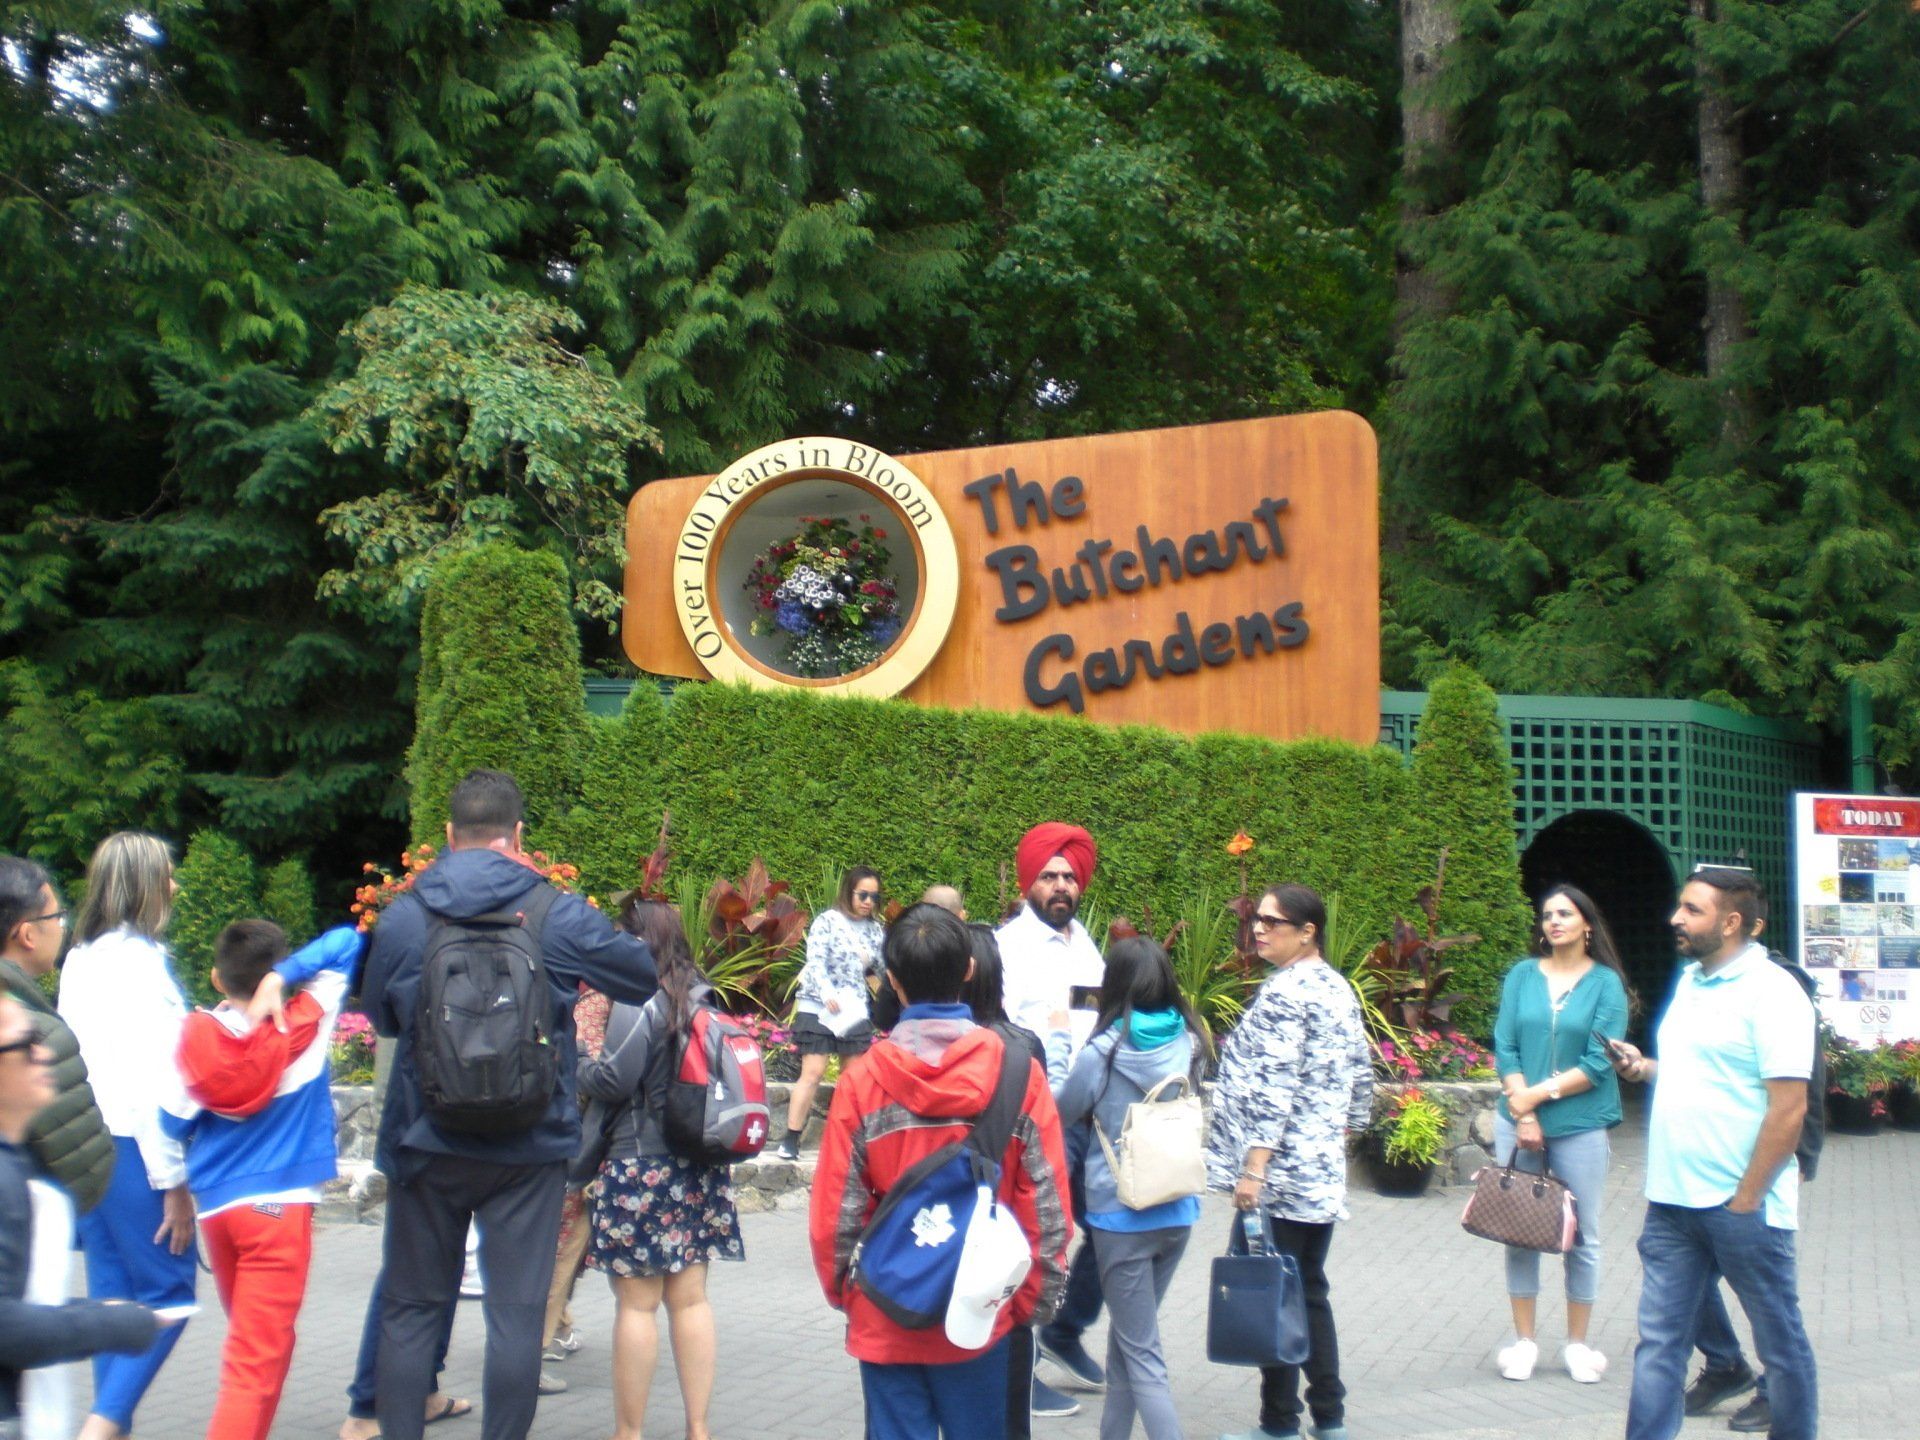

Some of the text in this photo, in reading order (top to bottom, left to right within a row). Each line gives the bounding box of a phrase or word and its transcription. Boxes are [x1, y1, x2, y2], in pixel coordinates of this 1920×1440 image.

[679, 439, 934, 659] Over 100 Years in Bloom
[963, 467, 1086, 533] The
[985, 497, 1289, 623] Butchart
[1023, 601, 1310, 713] Gardens
[1841, 809, 1905, 827] TODAY
